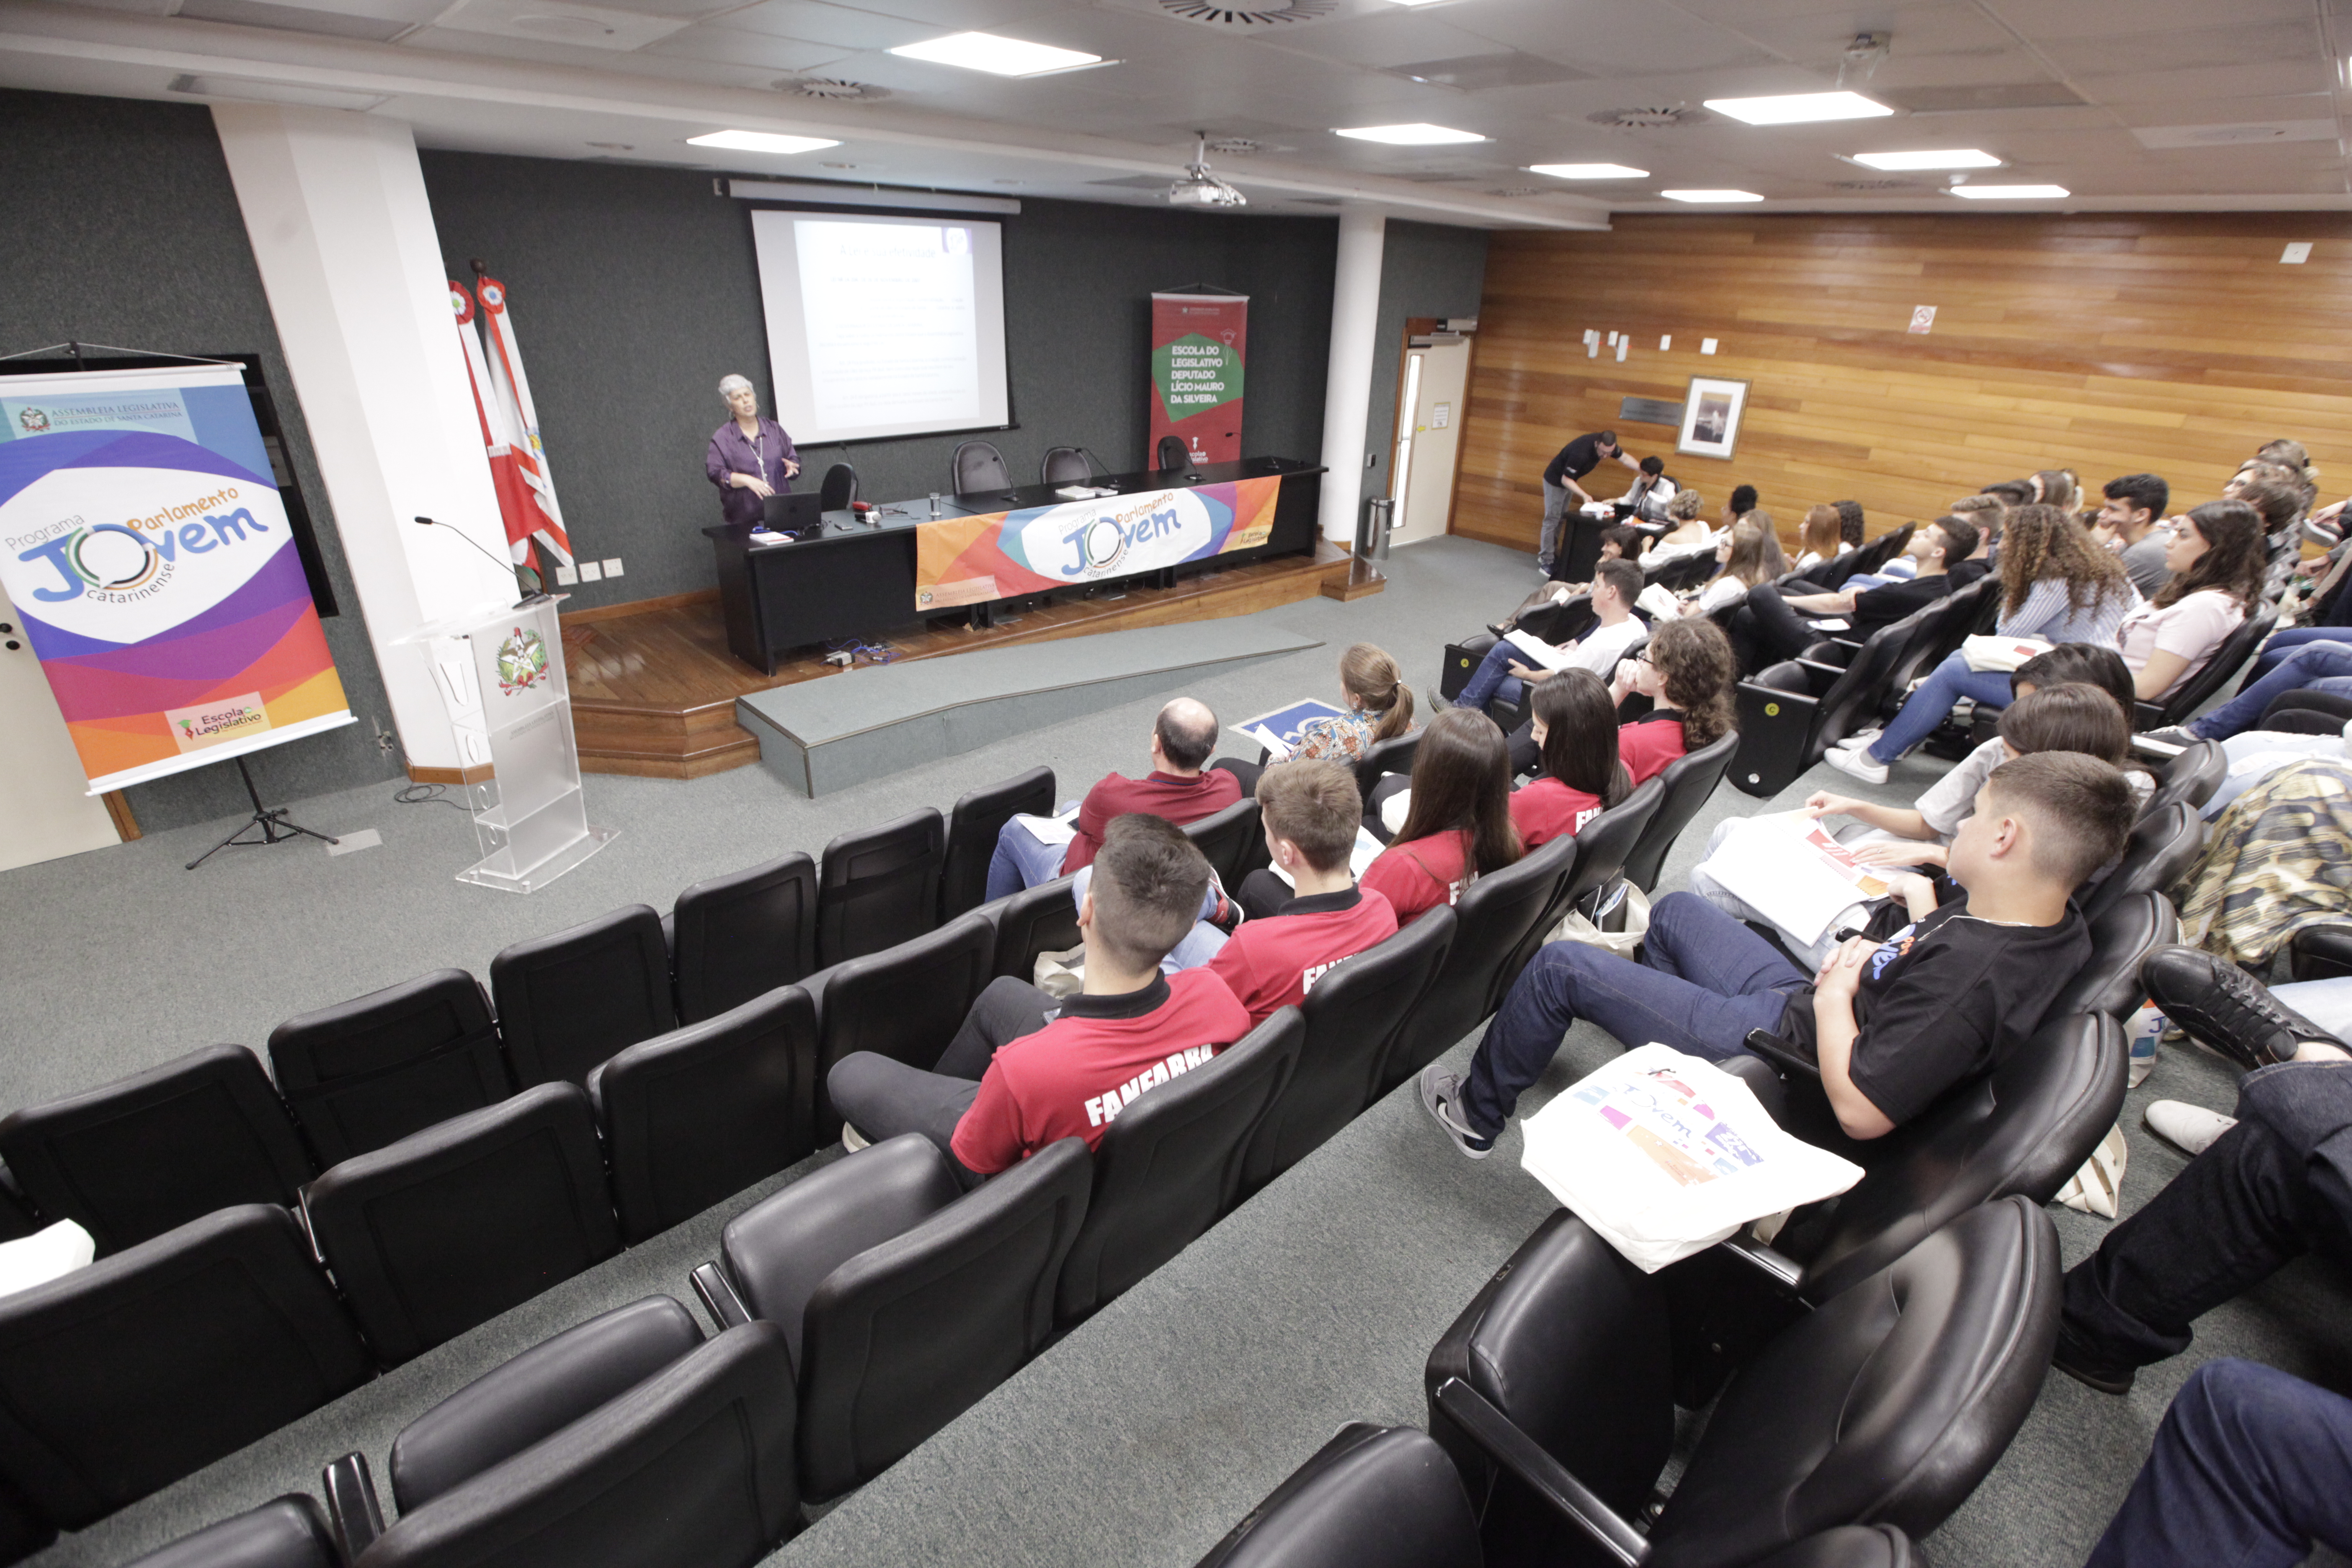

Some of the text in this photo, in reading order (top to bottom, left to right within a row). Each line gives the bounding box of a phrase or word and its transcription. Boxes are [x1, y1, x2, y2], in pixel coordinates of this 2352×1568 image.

[1172, 346, 1219, 355] ESCOLA DO
[1172, 358, 1222, 367] LEGISLATIVO
[1171, 371, 1215, 379] DEPUTADO
[1171, 382, 1224, 392] LÍCIO MAURO
[1171, 395, 1217, 403] DA SILVEIRA
[52, 402, 179, 417] ASSEMBLEIA LEGISLATIVA
[126, 487, 239, 533] Parlamento
[1116, 492, 1174, 524] Parlamento
[1058, 508, 1097, 535] Programa
[5, 513, 85, 552] Programa
[196, 714, 261, 735] Legislativo
[201, 709, 244, 725] Escola
